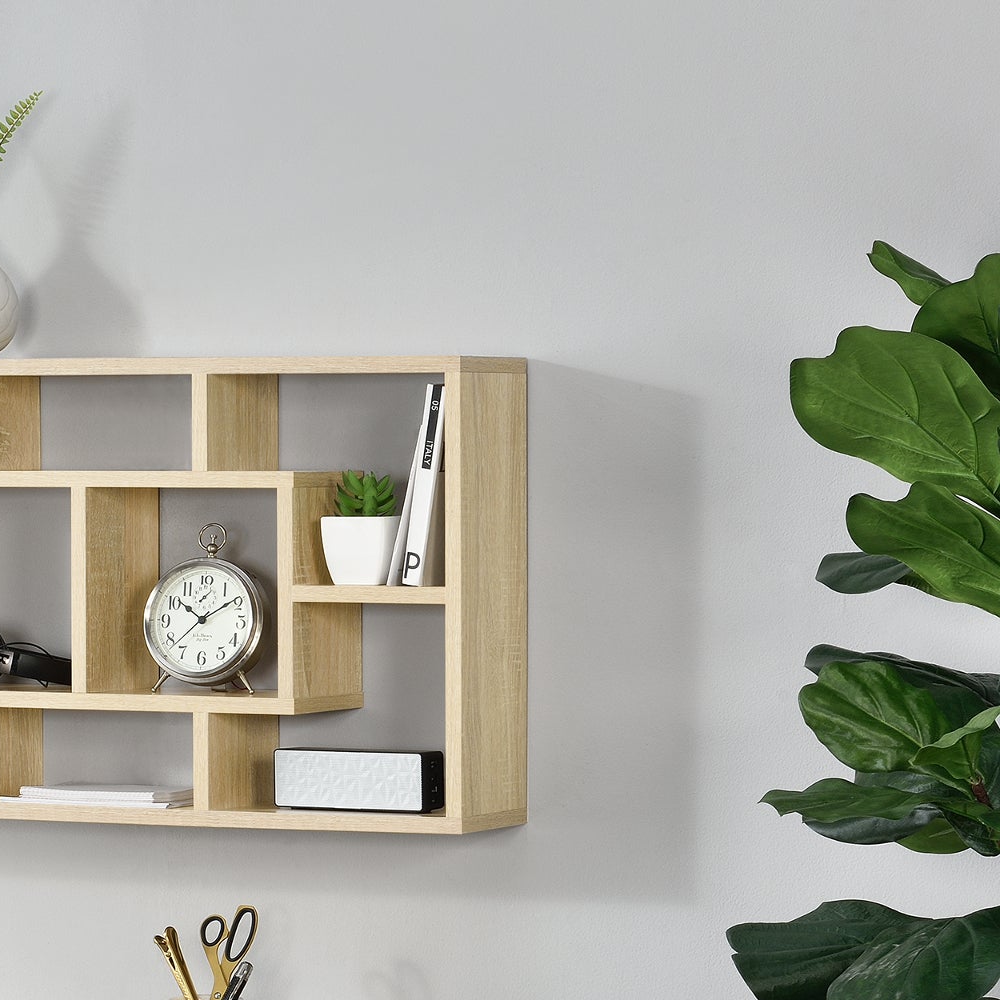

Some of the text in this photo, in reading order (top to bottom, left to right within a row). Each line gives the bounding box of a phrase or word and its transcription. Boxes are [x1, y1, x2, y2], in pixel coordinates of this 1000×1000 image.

[424, 440, 433, 465] ITALY
[404, 551, 421, 579] P
[162, 615, 170, 628] 9
[236, 616, 246, 629] 3
[166, 632, 175, 646] 8
[229, 633, 239, 647] 4
[179, 646, 187, 659] 7
[197, 651, 206, 665] 6
[216, 646, 225, 660] 5
